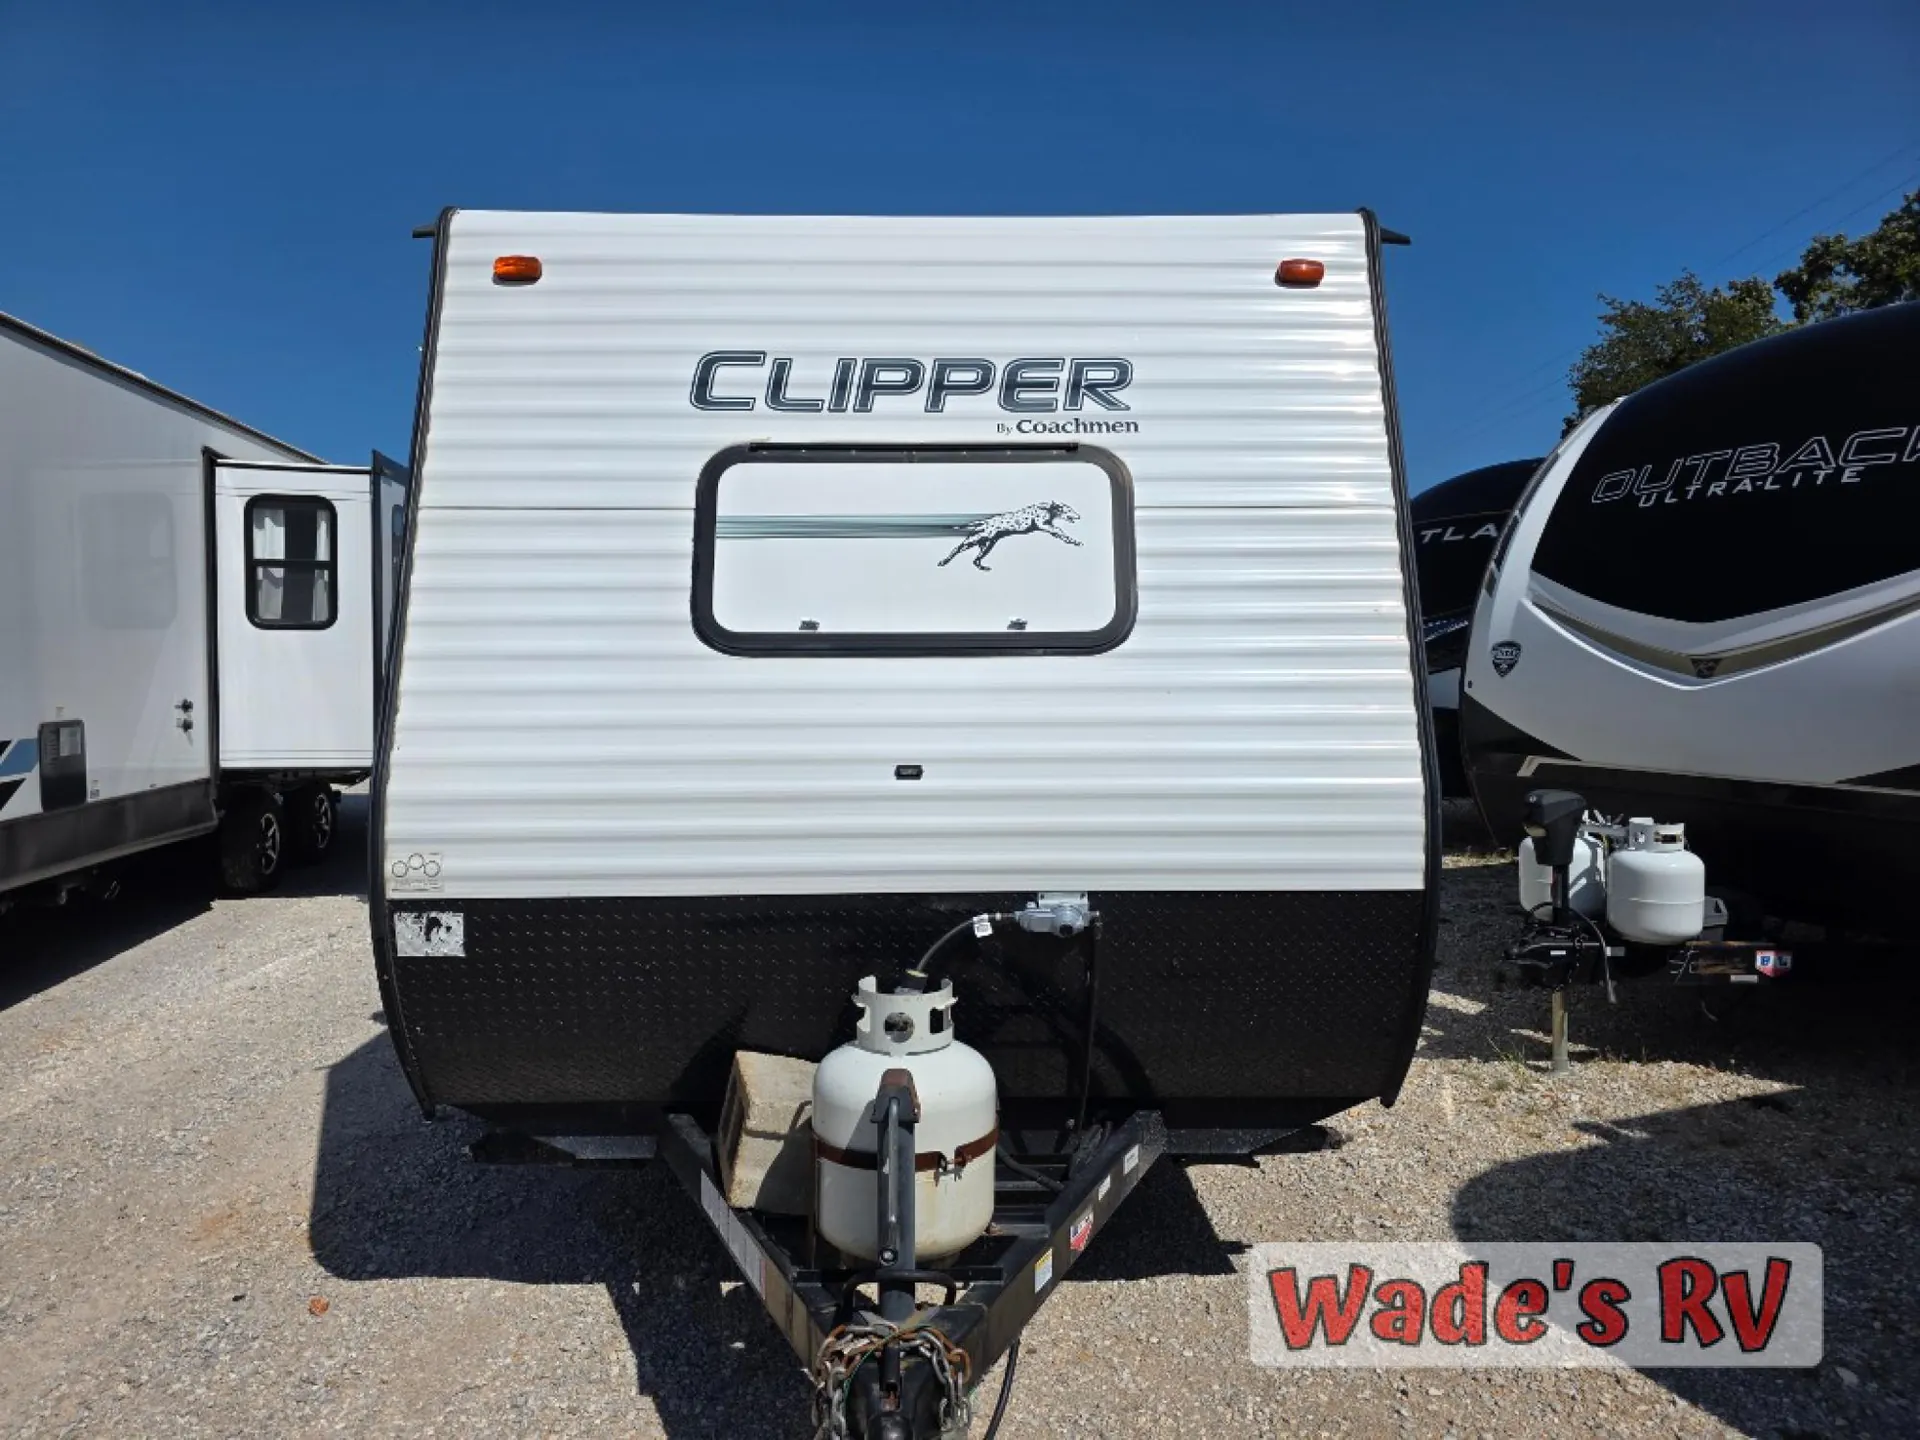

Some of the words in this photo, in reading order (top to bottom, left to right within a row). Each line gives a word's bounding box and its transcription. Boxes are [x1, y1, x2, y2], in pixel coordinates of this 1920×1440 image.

[689, 350, 1134, 413] CLIPPER
[996, 423, 1013, 435] By
[1016, 418, 1139, 434] Coachmen
[1638, 466, 1865, 507] ULTRA-LITE
